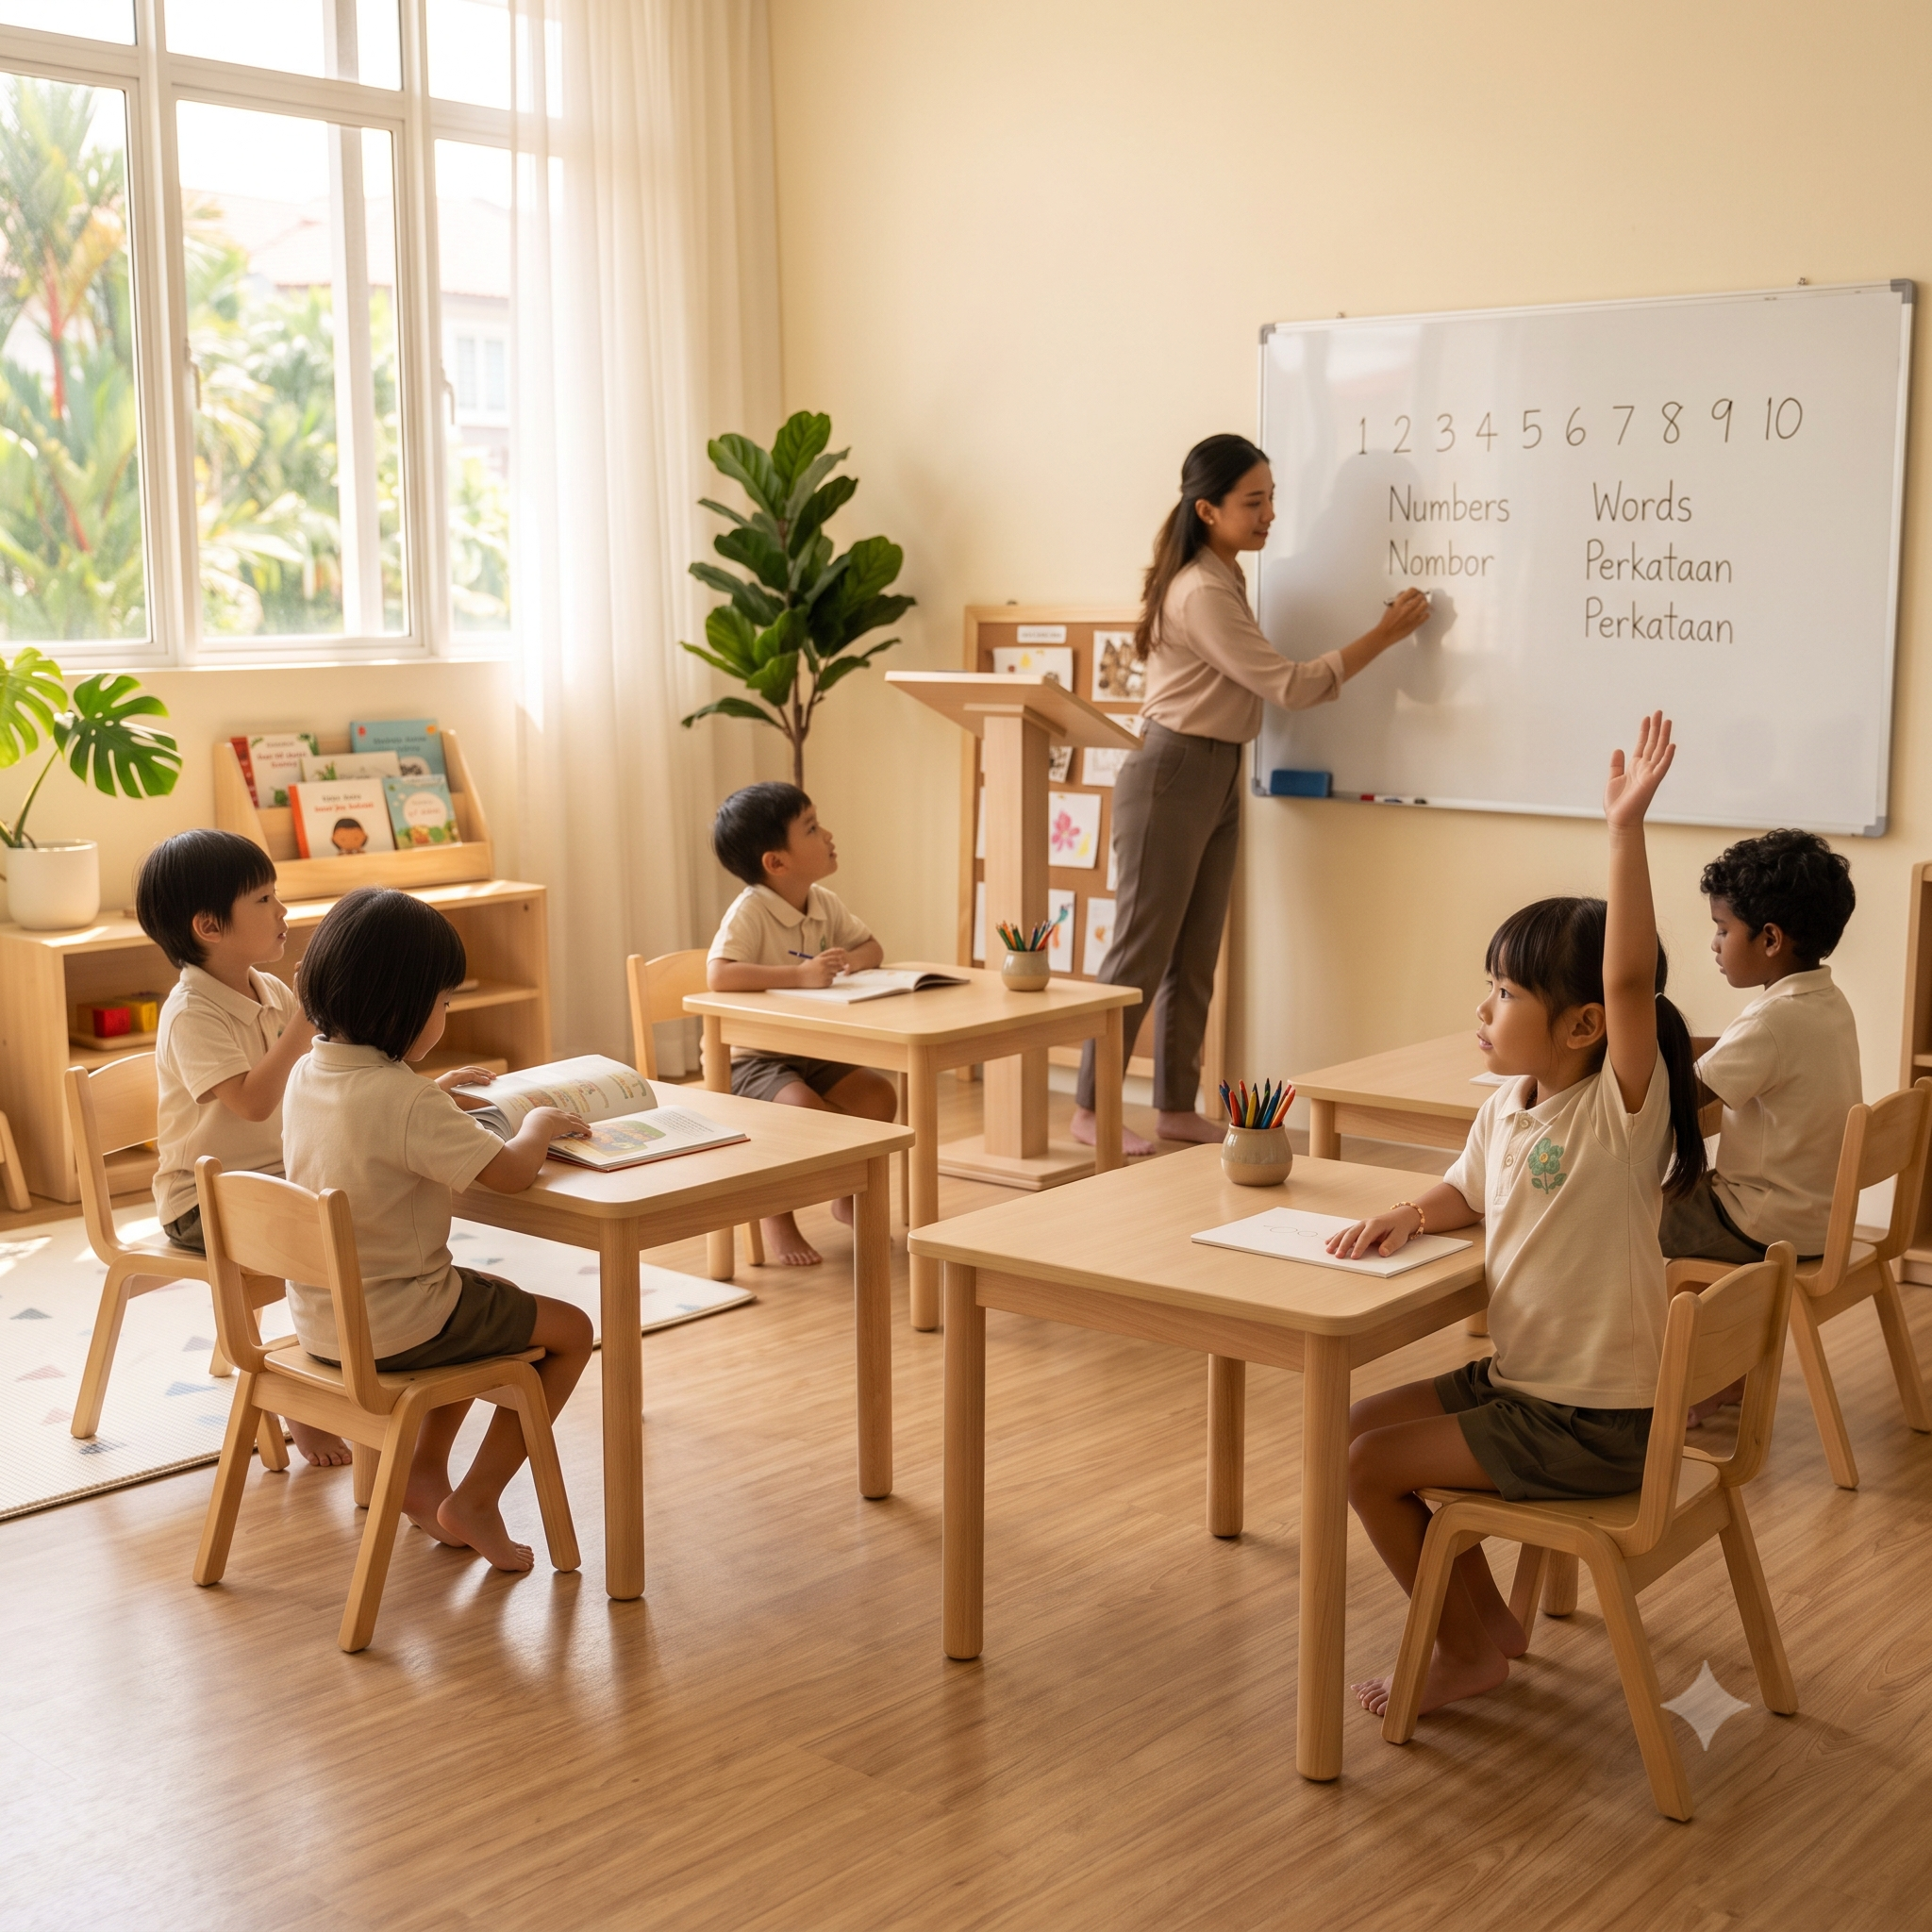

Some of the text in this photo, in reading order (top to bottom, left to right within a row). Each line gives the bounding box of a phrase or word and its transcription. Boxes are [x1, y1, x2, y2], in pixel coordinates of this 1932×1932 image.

[1357, 396, 1804, 456] 1 2 3 4 5 6 7 8 9 10
[1389, 482, 1510, 523] Numbers
[1592, 479, 1692, 523] Words
[1389, 539, 1494, 576] Nombor
[1586, 538, 1732, 583] Perkataan
[1585, 596, 1733, 643] Perkataan
